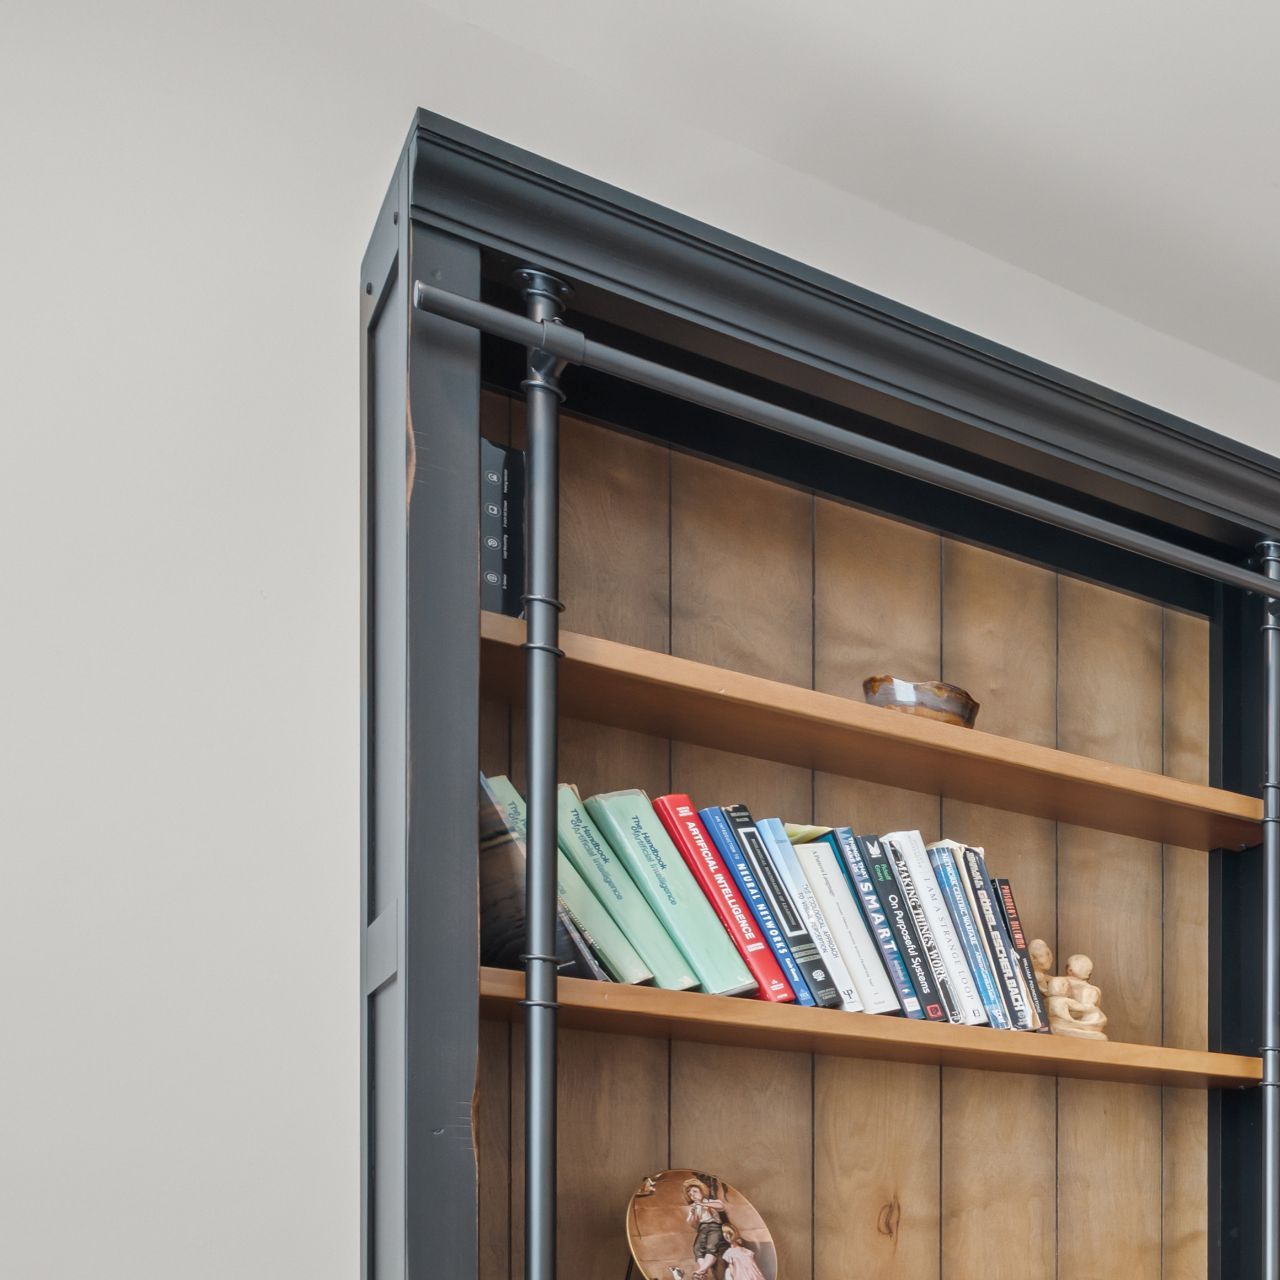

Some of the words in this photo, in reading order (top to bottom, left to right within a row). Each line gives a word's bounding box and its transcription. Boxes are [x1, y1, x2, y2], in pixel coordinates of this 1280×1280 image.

[570, 819, 580, 830] of
[570, 808, 582, 824] The
[582, 825, 610, 864] Handbook
[574, 826, 598, 857] Artificial
[630, 826, 640, 836] of
[631, 816, 643, 831] The
[642, 832, 668, 870] Handbook
[633, 832, 652, 862] Artificial
[847, 837, 860, 860] THINGS
[857, 862, 868, 877] THAT
[591, 856, 623, 900] Intelligence
[650, 862, 678, 906] Intelligence
[687, 822, 716, 871] ARTIFICIAL
[715, 874, 753, 938] INTELLIGENCE
[942, 853, 957, 884] NETWORK
[953, 886, 967, 914] CENTRIC
[963, 915, 977, 944] WARFARE
[737, 863, 759, 898] NEURAL
[757, 904, 786, 953] NETWORKS
[860, 882, 898, 952] SMART
[895, 859, 918, 905] MAKING
[913, 906, 932, 947] THINGS
[928, 949, 945, 982] WORK
[888, 894, 898, 908] On
[894, 910, 916, 955] Purposeful
[911, 957, 929, 993] Systems
[1011, 921, 1024, 948] DILEMMA
[939, 916, 961, 963] STRANGE
[958, 970, 973, 999] LOOP
[1022, 958, 1031, 978] WILLIAM
[1006, 979, 1023, 1010] BACH
